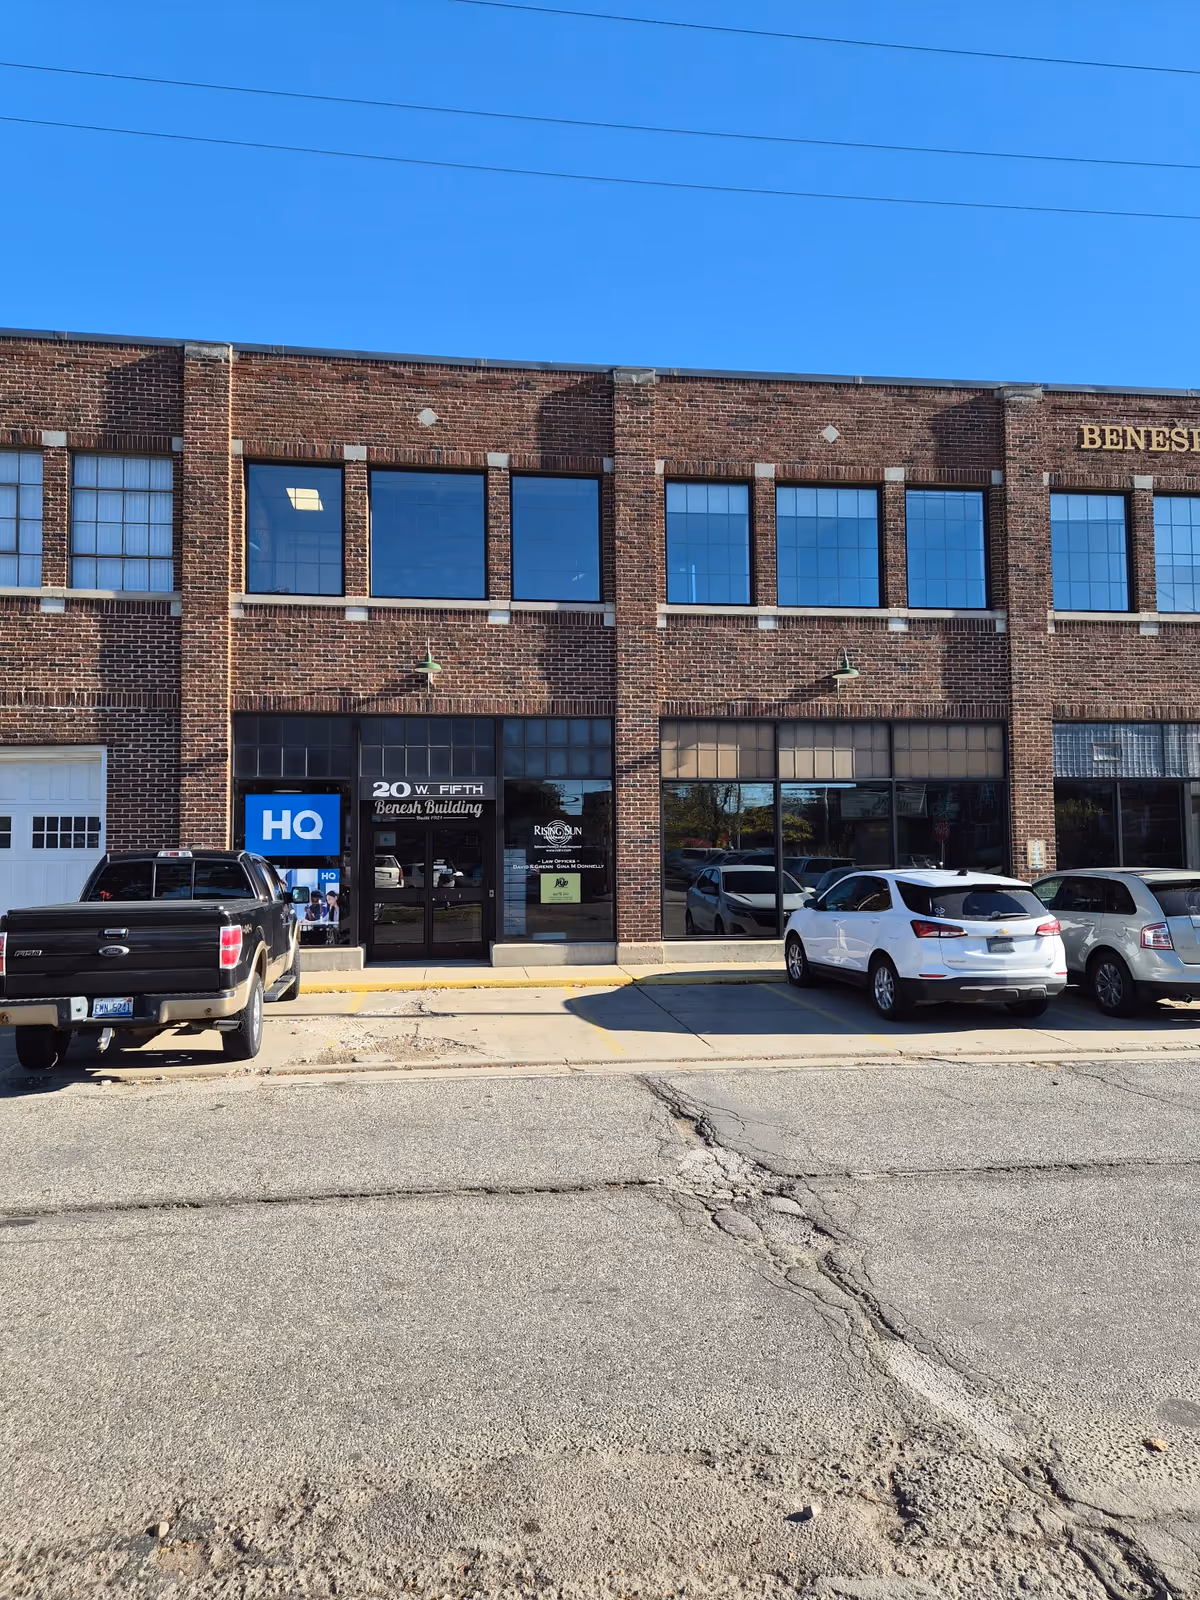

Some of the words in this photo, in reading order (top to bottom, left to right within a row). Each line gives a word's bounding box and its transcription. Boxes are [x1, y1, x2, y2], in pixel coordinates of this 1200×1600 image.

[372, 781, 411, 798] 20
[415, 785, 430, 795] W.
[439, 785, 483, 795] FIFTH
[374, 799, 423, 815] Benesh
[424, 799, 484, 818] Building
[262, 810, 323, 841] HQ
[534, 825, 562, 836] RISING
[564, 825, 582, 835] SUN
[321, 872, 336, 880] HQ
